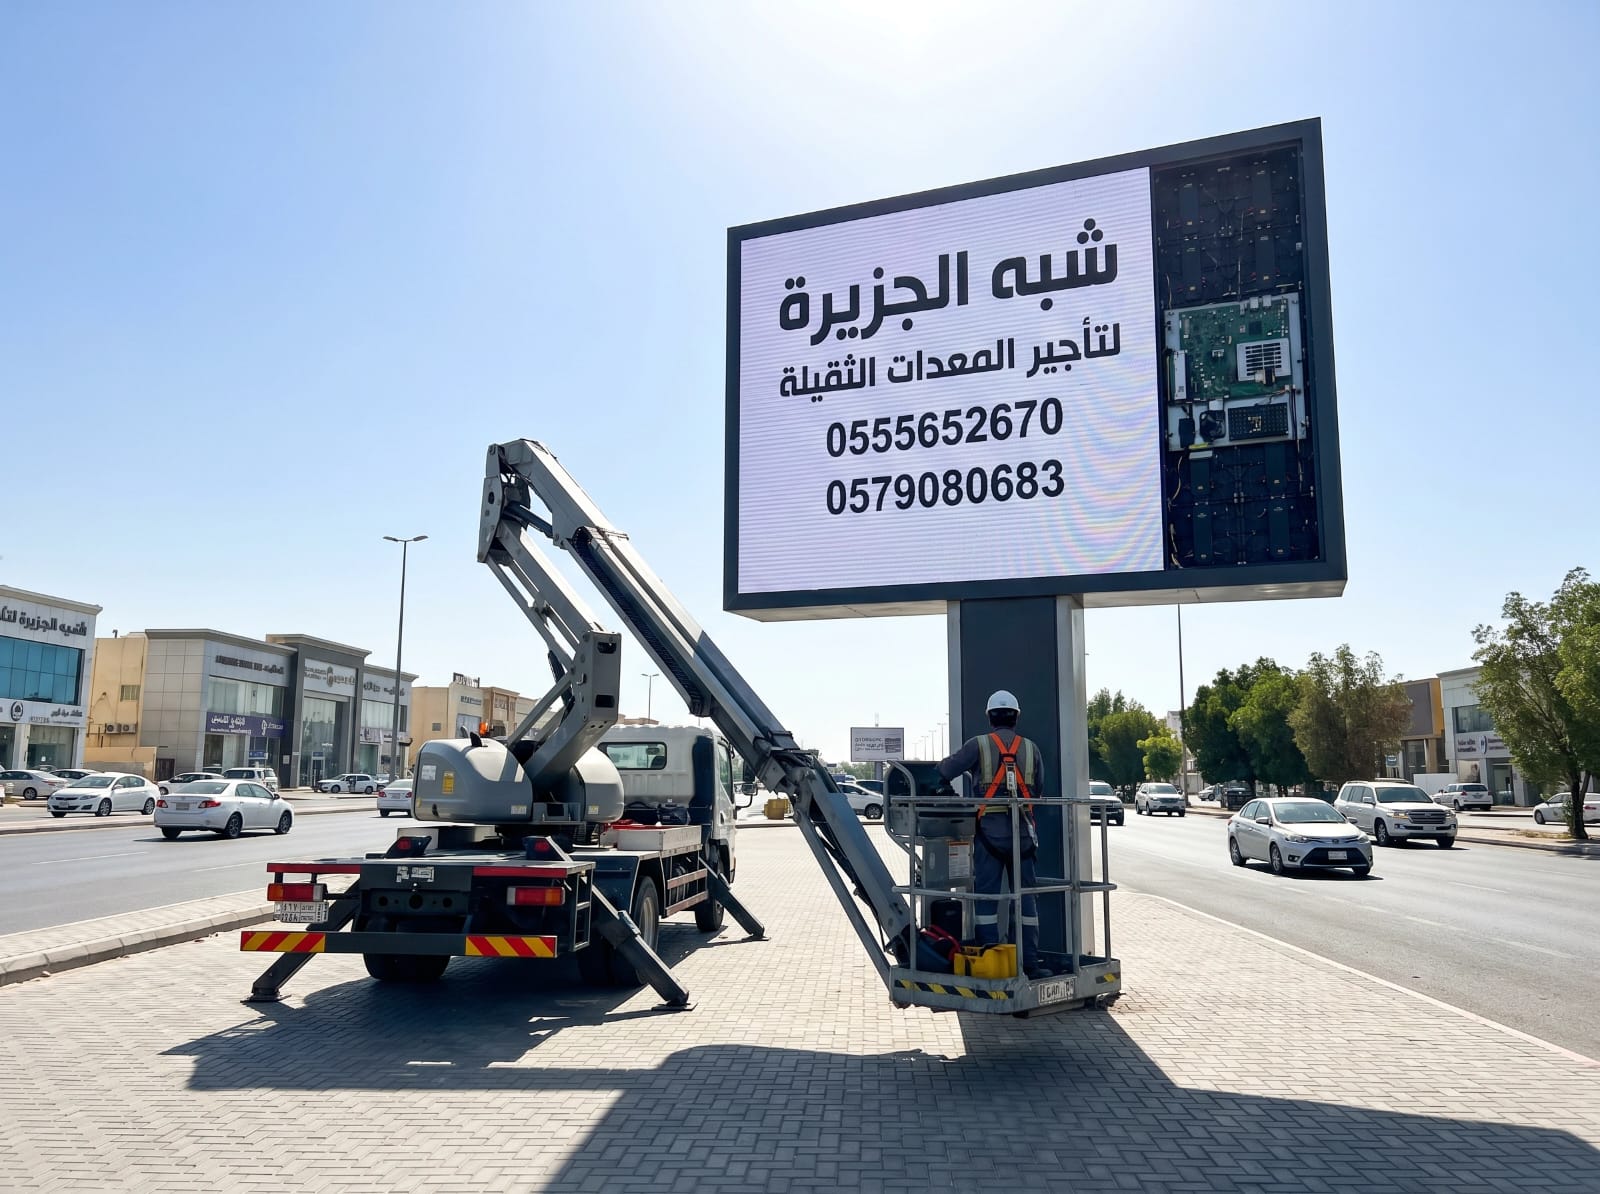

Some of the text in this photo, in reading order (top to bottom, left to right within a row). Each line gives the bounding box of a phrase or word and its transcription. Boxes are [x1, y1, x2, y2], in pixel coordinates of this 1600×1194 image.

[779, 218, 1118, 347] شبه الجزيرة
[779, 316, 1121, 403] لتأجير المعدات الثقيلة
[826, 397, 1064, 458] 0555652670
[826, 459, 1065, 515] 0579080683
